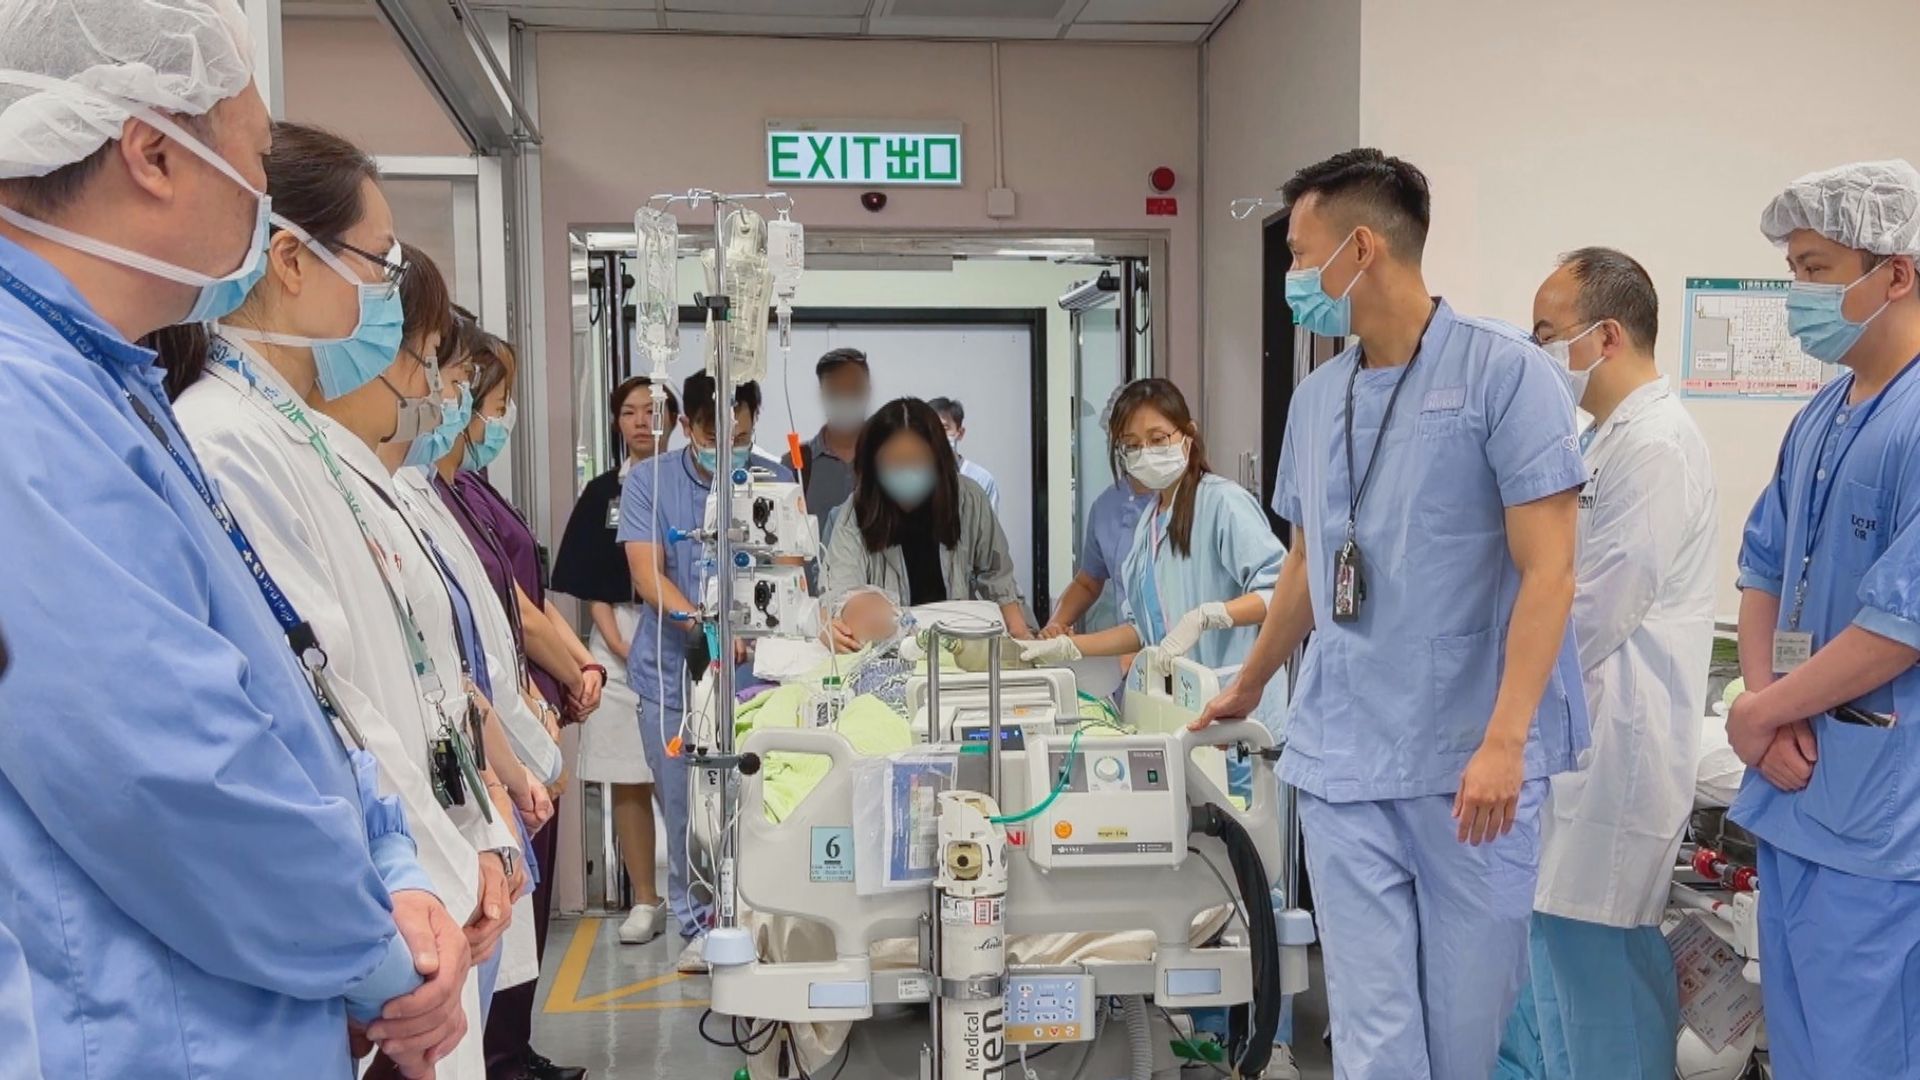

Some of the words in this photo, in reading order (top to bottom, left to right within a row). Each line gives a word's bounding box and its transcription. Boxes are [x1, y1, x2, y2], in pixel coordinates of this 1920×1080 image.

[771, 136, 881, 179] EXIT
[886, 137, 957, 180] 出口
[825, 833, 842, 859] 6
[963, 1011, 980, 1071] Medical
